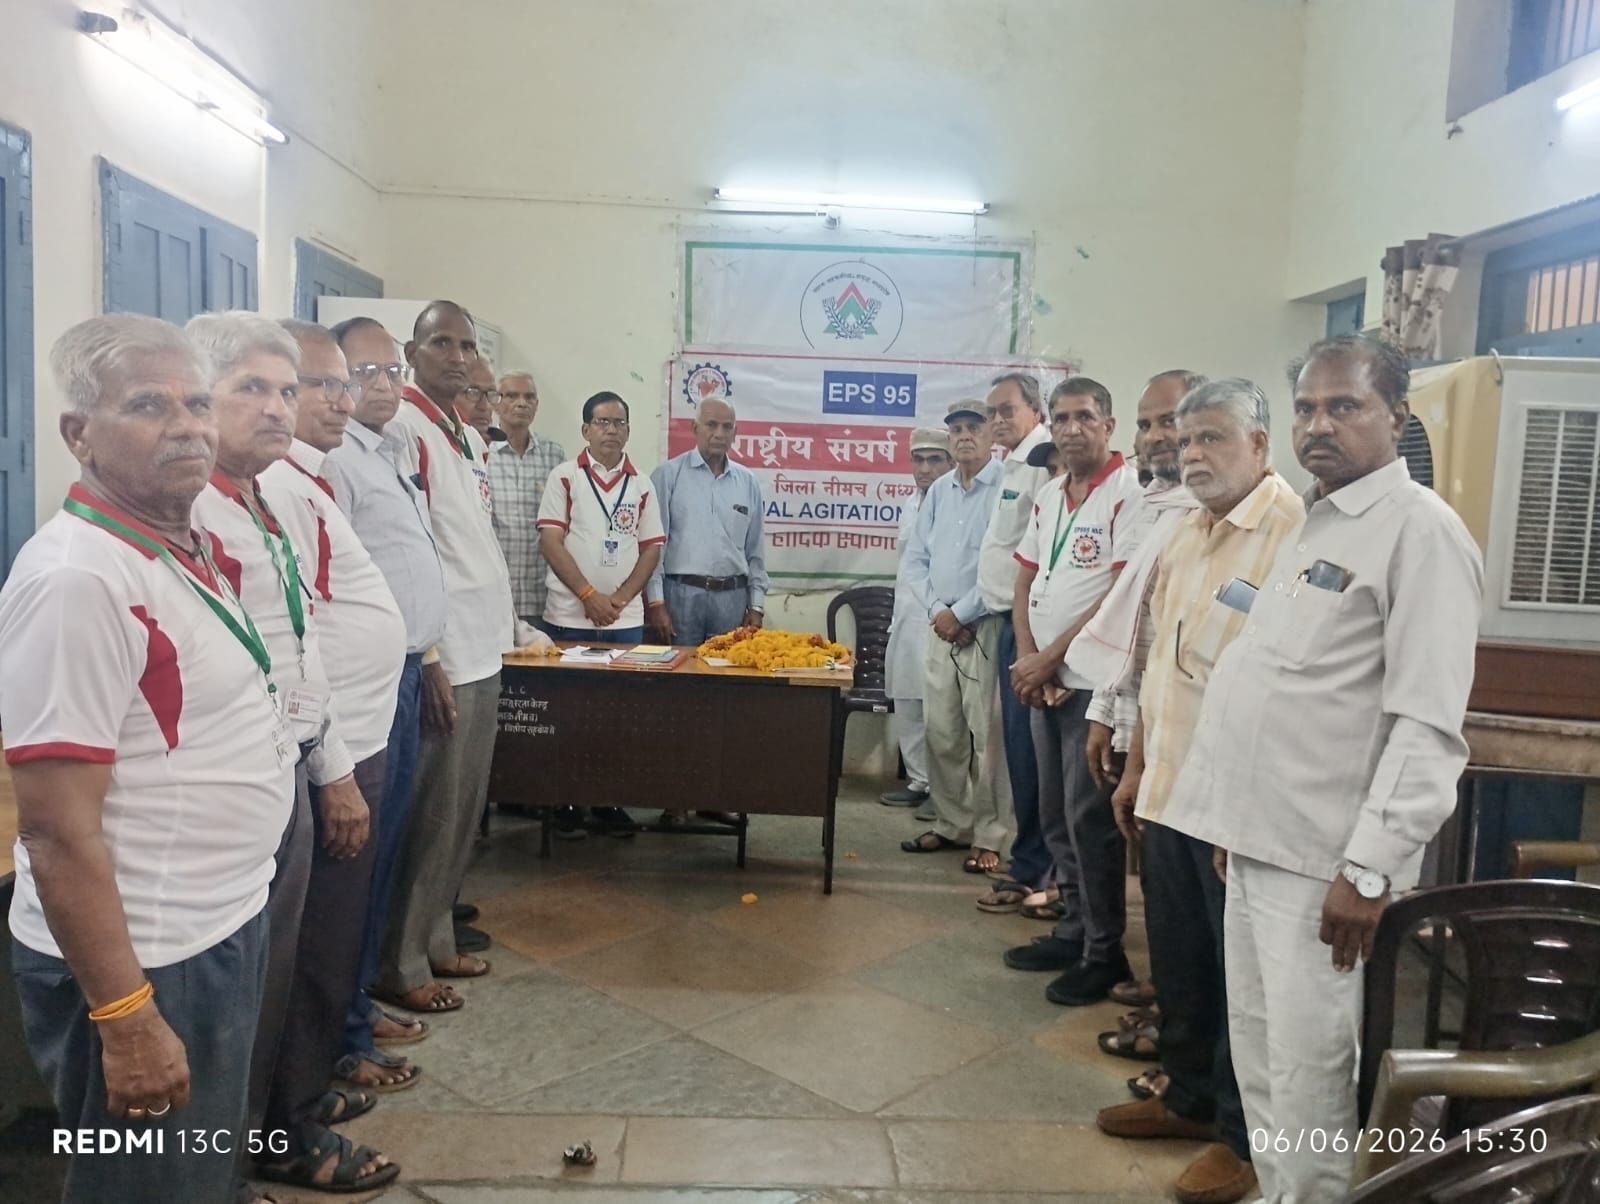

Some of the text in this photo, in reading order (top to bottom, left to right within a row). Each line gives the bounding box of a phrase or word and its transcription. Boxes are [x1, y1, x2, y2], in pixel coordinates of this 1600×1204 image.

[828, 382, 911, 405] EPS 95
[731, 426, 898, 467] राष्ट्रीय संघर्ष
[774, 473, 816, 496] जिला
[822, 476, 868, 498] नीमच
[763, 500, 794, 518] AL
